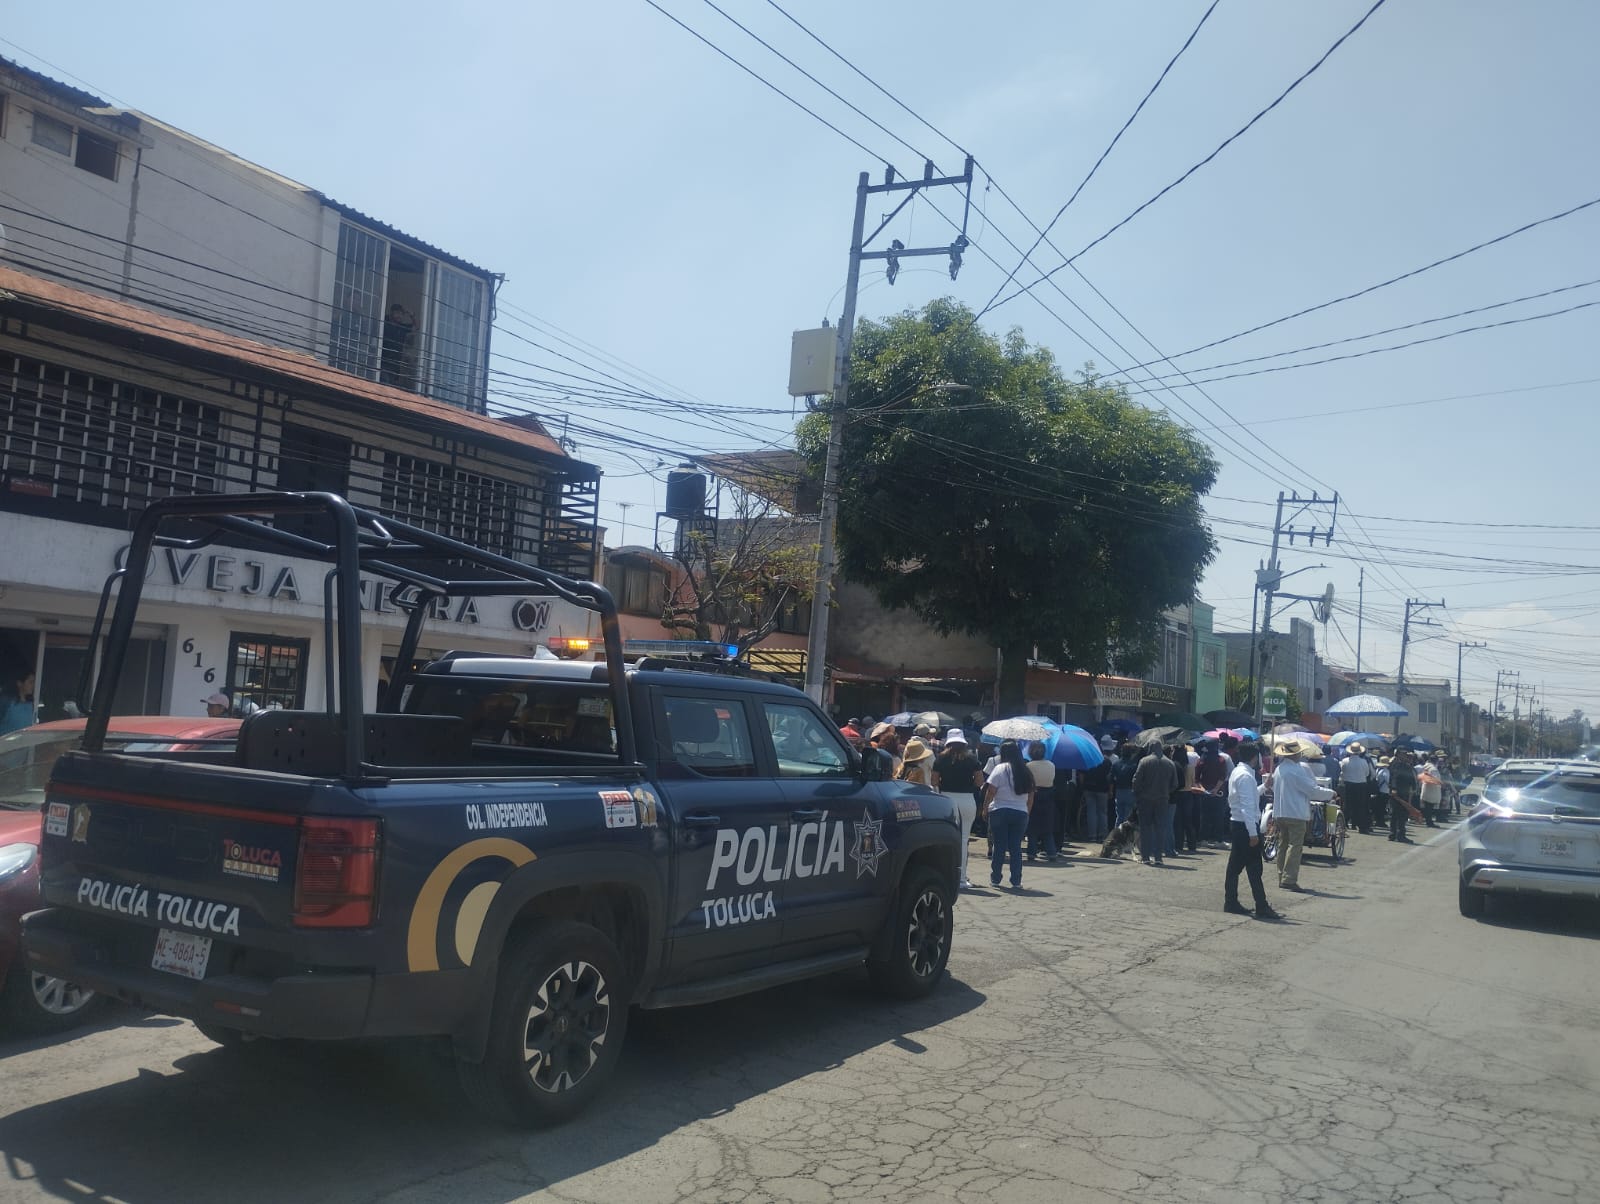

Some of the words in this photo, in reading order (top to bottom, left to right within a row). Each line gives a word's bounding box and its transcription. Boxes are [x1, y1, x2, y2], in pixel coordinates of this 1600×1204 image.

[465, 803, 486, 830] COL.
[484, 802, 549, 829] INDEPENDENCIA
[224, 838, 282, 867] TOLUCA
[706, 810, 845, 891] POLICÍA
[77, 877, 149, 918] POLICÍA
[156, 892, 241, 937] TOLUCA
[701, 890, 777, 929] TOLUCA
